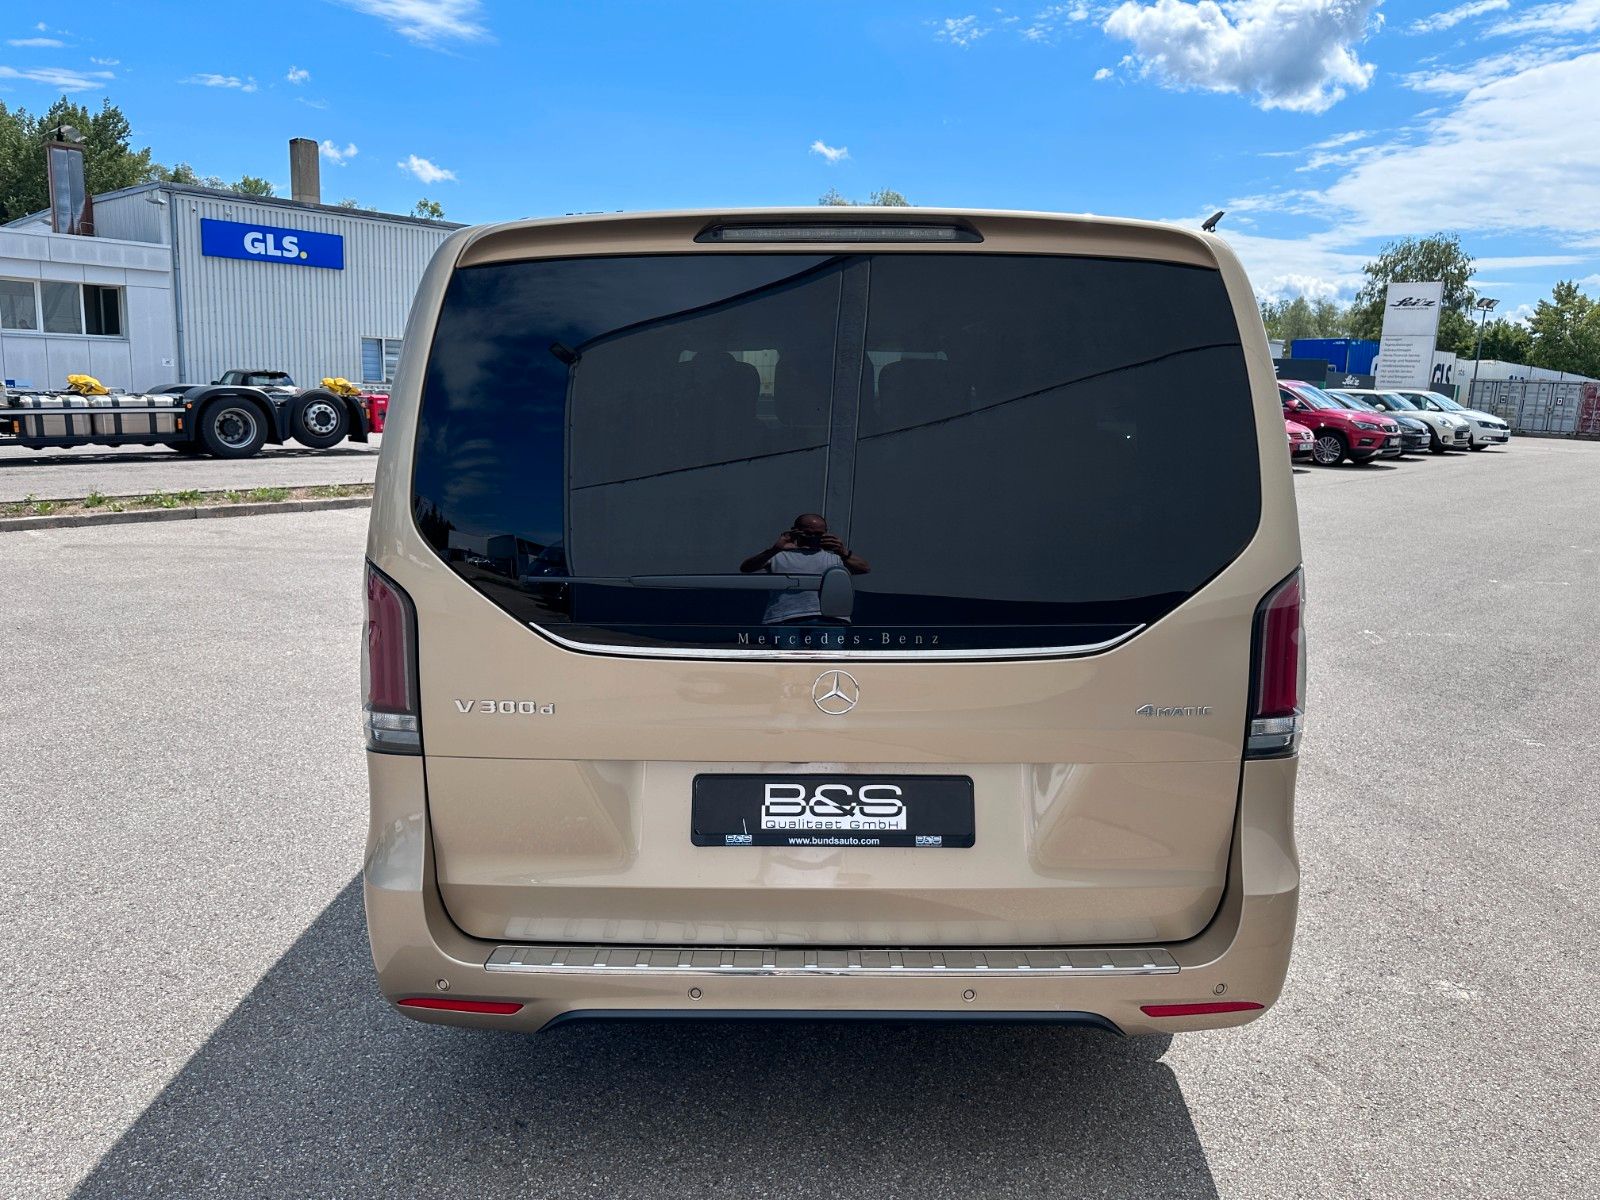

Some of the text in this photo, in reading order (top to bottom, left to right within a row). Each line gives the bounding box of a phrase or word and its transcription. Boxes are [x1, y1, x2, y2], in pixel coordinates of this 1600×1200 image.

[737, 632, 940, 645] Mercedes-Benz
[1135, 703, 1214, 717] 4MATIC
[764, 783, 903, 818] B&S
[765, 818, 899, 830] Qualitaet GmbH
[788, 836, 880, 846] www.bundsauto.com
